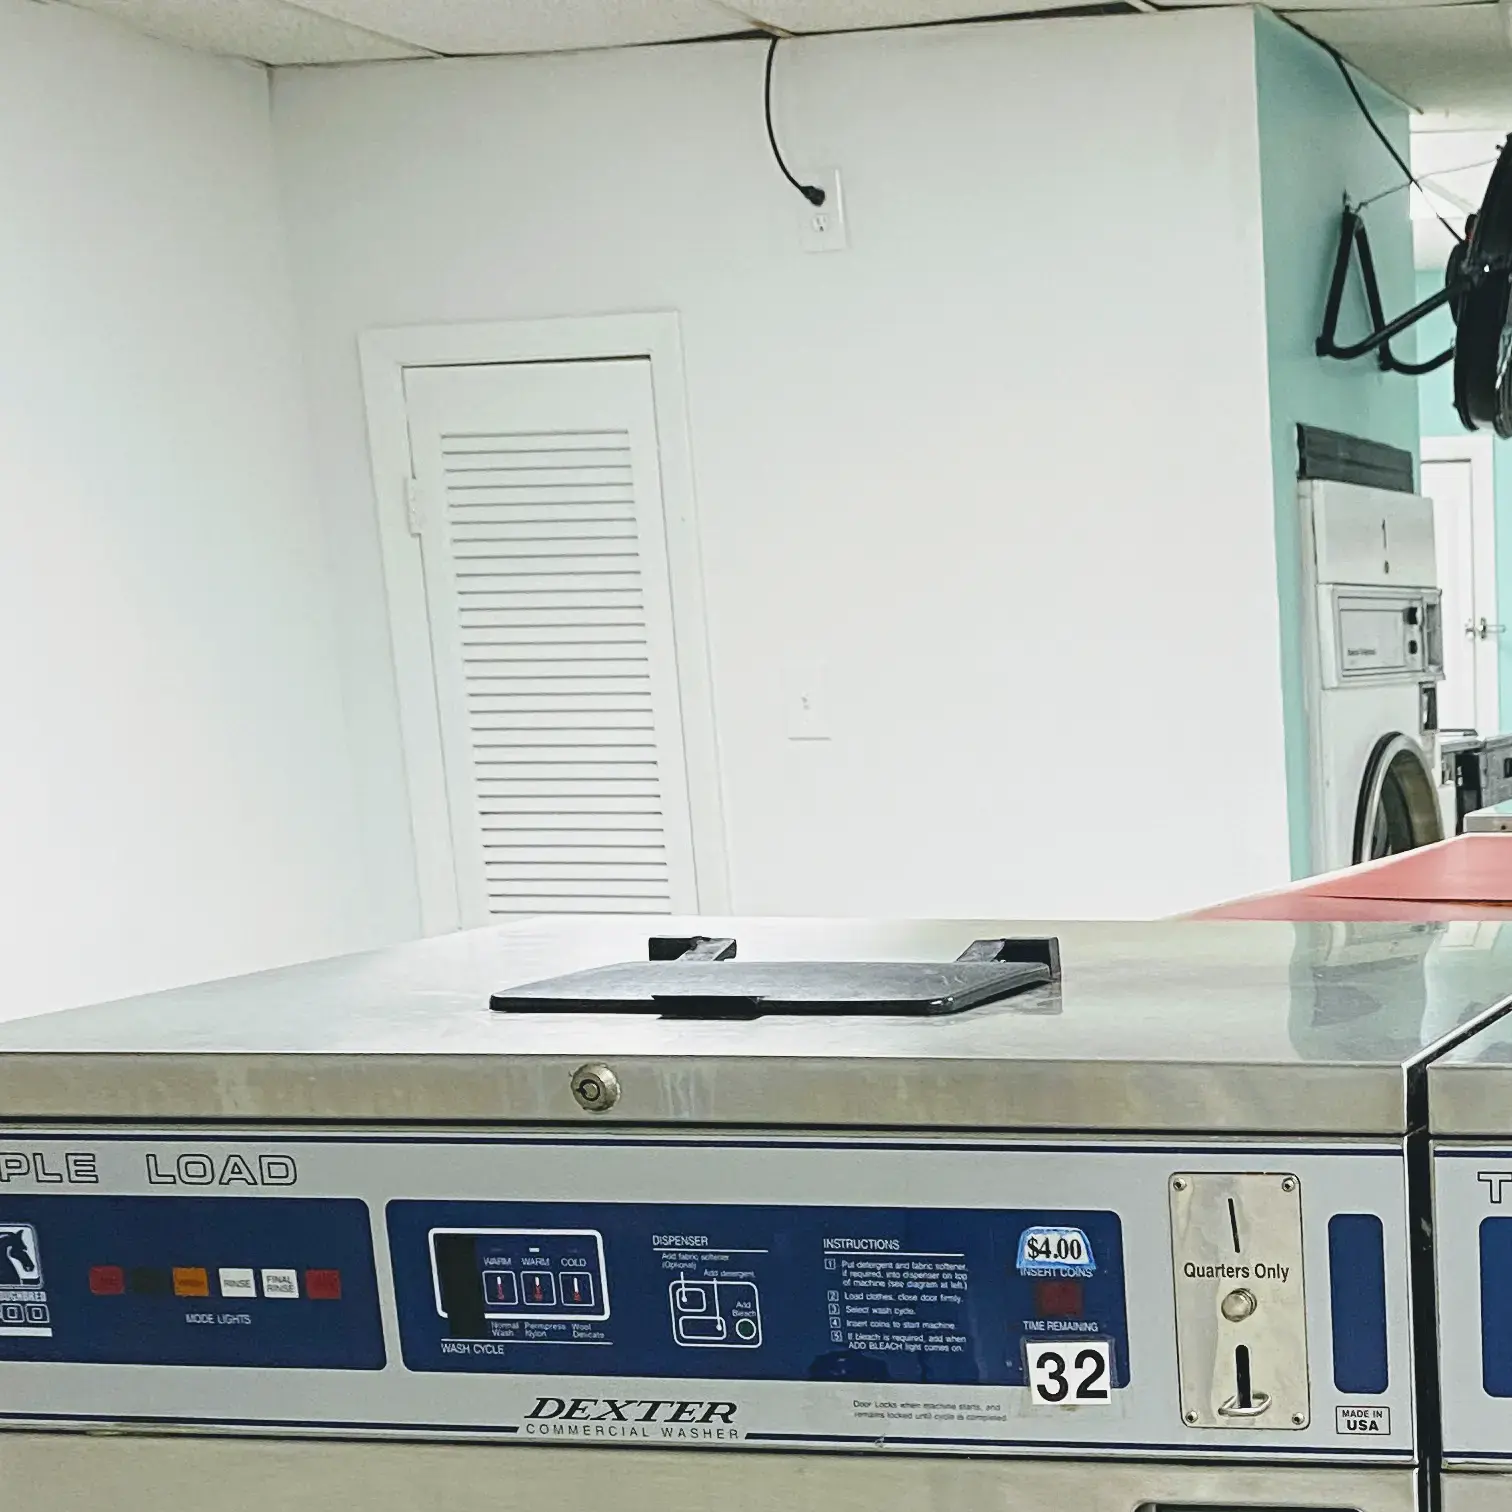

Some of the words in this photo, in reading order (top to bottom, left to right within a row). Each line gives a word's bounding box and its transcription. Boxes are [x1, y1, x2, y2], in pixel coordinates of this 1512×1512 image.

[146, 1154, 297, 1185] LOAD
[652, 1235, 708, 1246] DISPENSER
[823, 1239, 899, 1250] INSTRUCTIONS
[1027, 1236, 1082, 1260] $4.00
[522, 1258, 549, 1266] WARM
[1184, 1263, 1249, 1278] Quarters
[1255, 1264, 1289, 1282] Only
[224, 1280, 250, 1288] RINSE
[267, 1276, 292, 1284] FINAL
[267, 1284, 294, 1292] RINSE
[0, 1303, 50, 1323] 00
[185, 1314, 214, 1324] MODE
[217, 1314, 251, 1325] LIGHTS
[1023, 1321, 1044, 1330] TIME
[1047, 1321, 1098, 1332] REMAINING
[441, 1344, 470, 1353] WASH
[473, 1344, 504, 1354] CYCLE
[1036, 1349, 1108, 1402] 32
[524, 1397, 738, 1424] DEXTER
[1342, 1409, 1368, 1418] MADE
[1373, 1410, 1383, 1418] IN
[1347, 1420, 1379, 1431] USA
[526, 1424, 649, 1437] COMMERCIAL
[661, 1427, 739, 1440] WASHER
